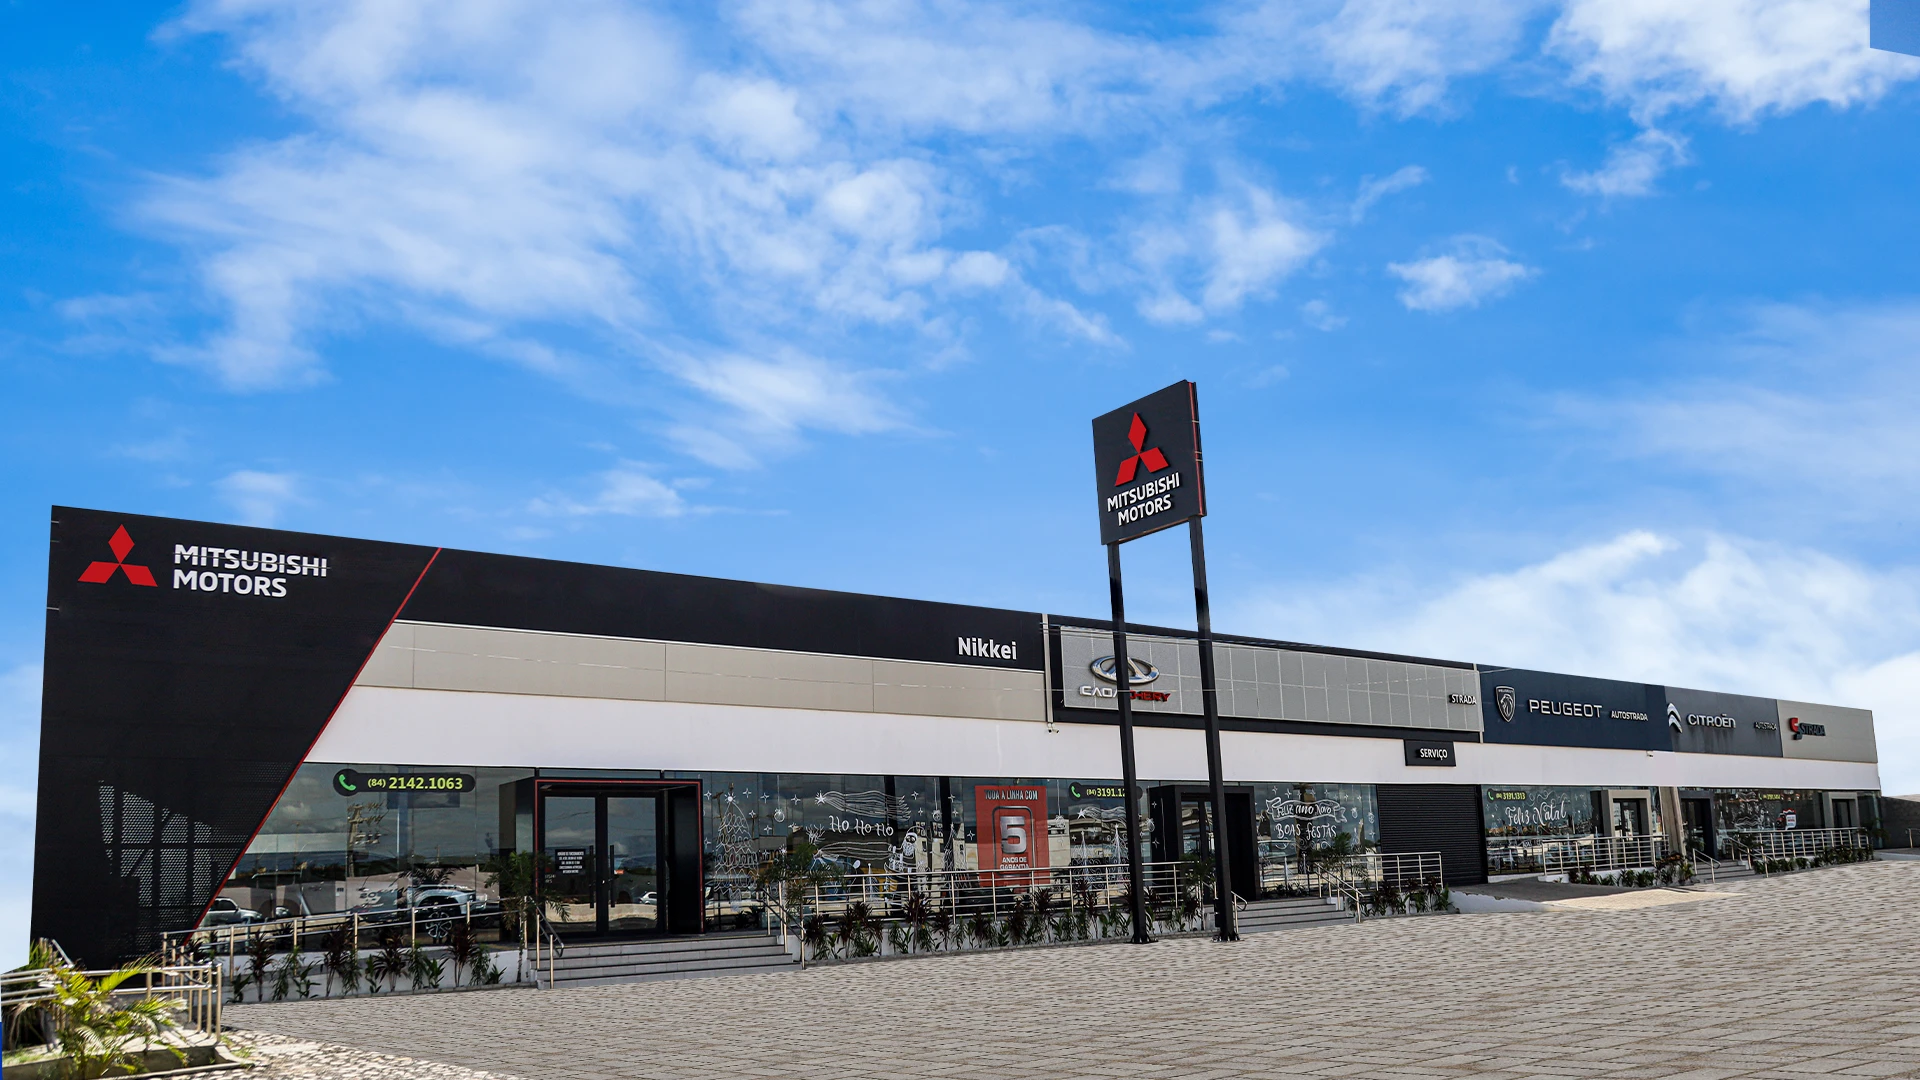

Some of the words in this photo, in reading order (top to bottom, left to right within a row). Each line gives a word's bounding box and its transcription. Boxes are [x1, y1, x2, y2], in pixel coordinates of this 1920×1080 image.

[1107, 472, 1181, 512] MITSUBISHI
[1117, 494, 1172, 526] MOTORS
[174, 543, 328, 577] MITSUBISHI
[173, 569, 287, 598] MOTORS
[957, 636, 1017, 660] Nikkei
[1450, 693, 1477, 705] STRADA
[1528, 699, 1602, 718] PEUGEOT
[1611, 710, 1649, 722] AUTOSTRADA
[1420, 748, 1448, 761] SERVIÇO
[367, 778, 386, 788] (84)
[388, 777, 463, 790] 2142.1063
[1096, 787, 1126, 797] 3191.1
[1024, 790, 1039, 800] COM
[1000, 816, 1027, 854] 5
